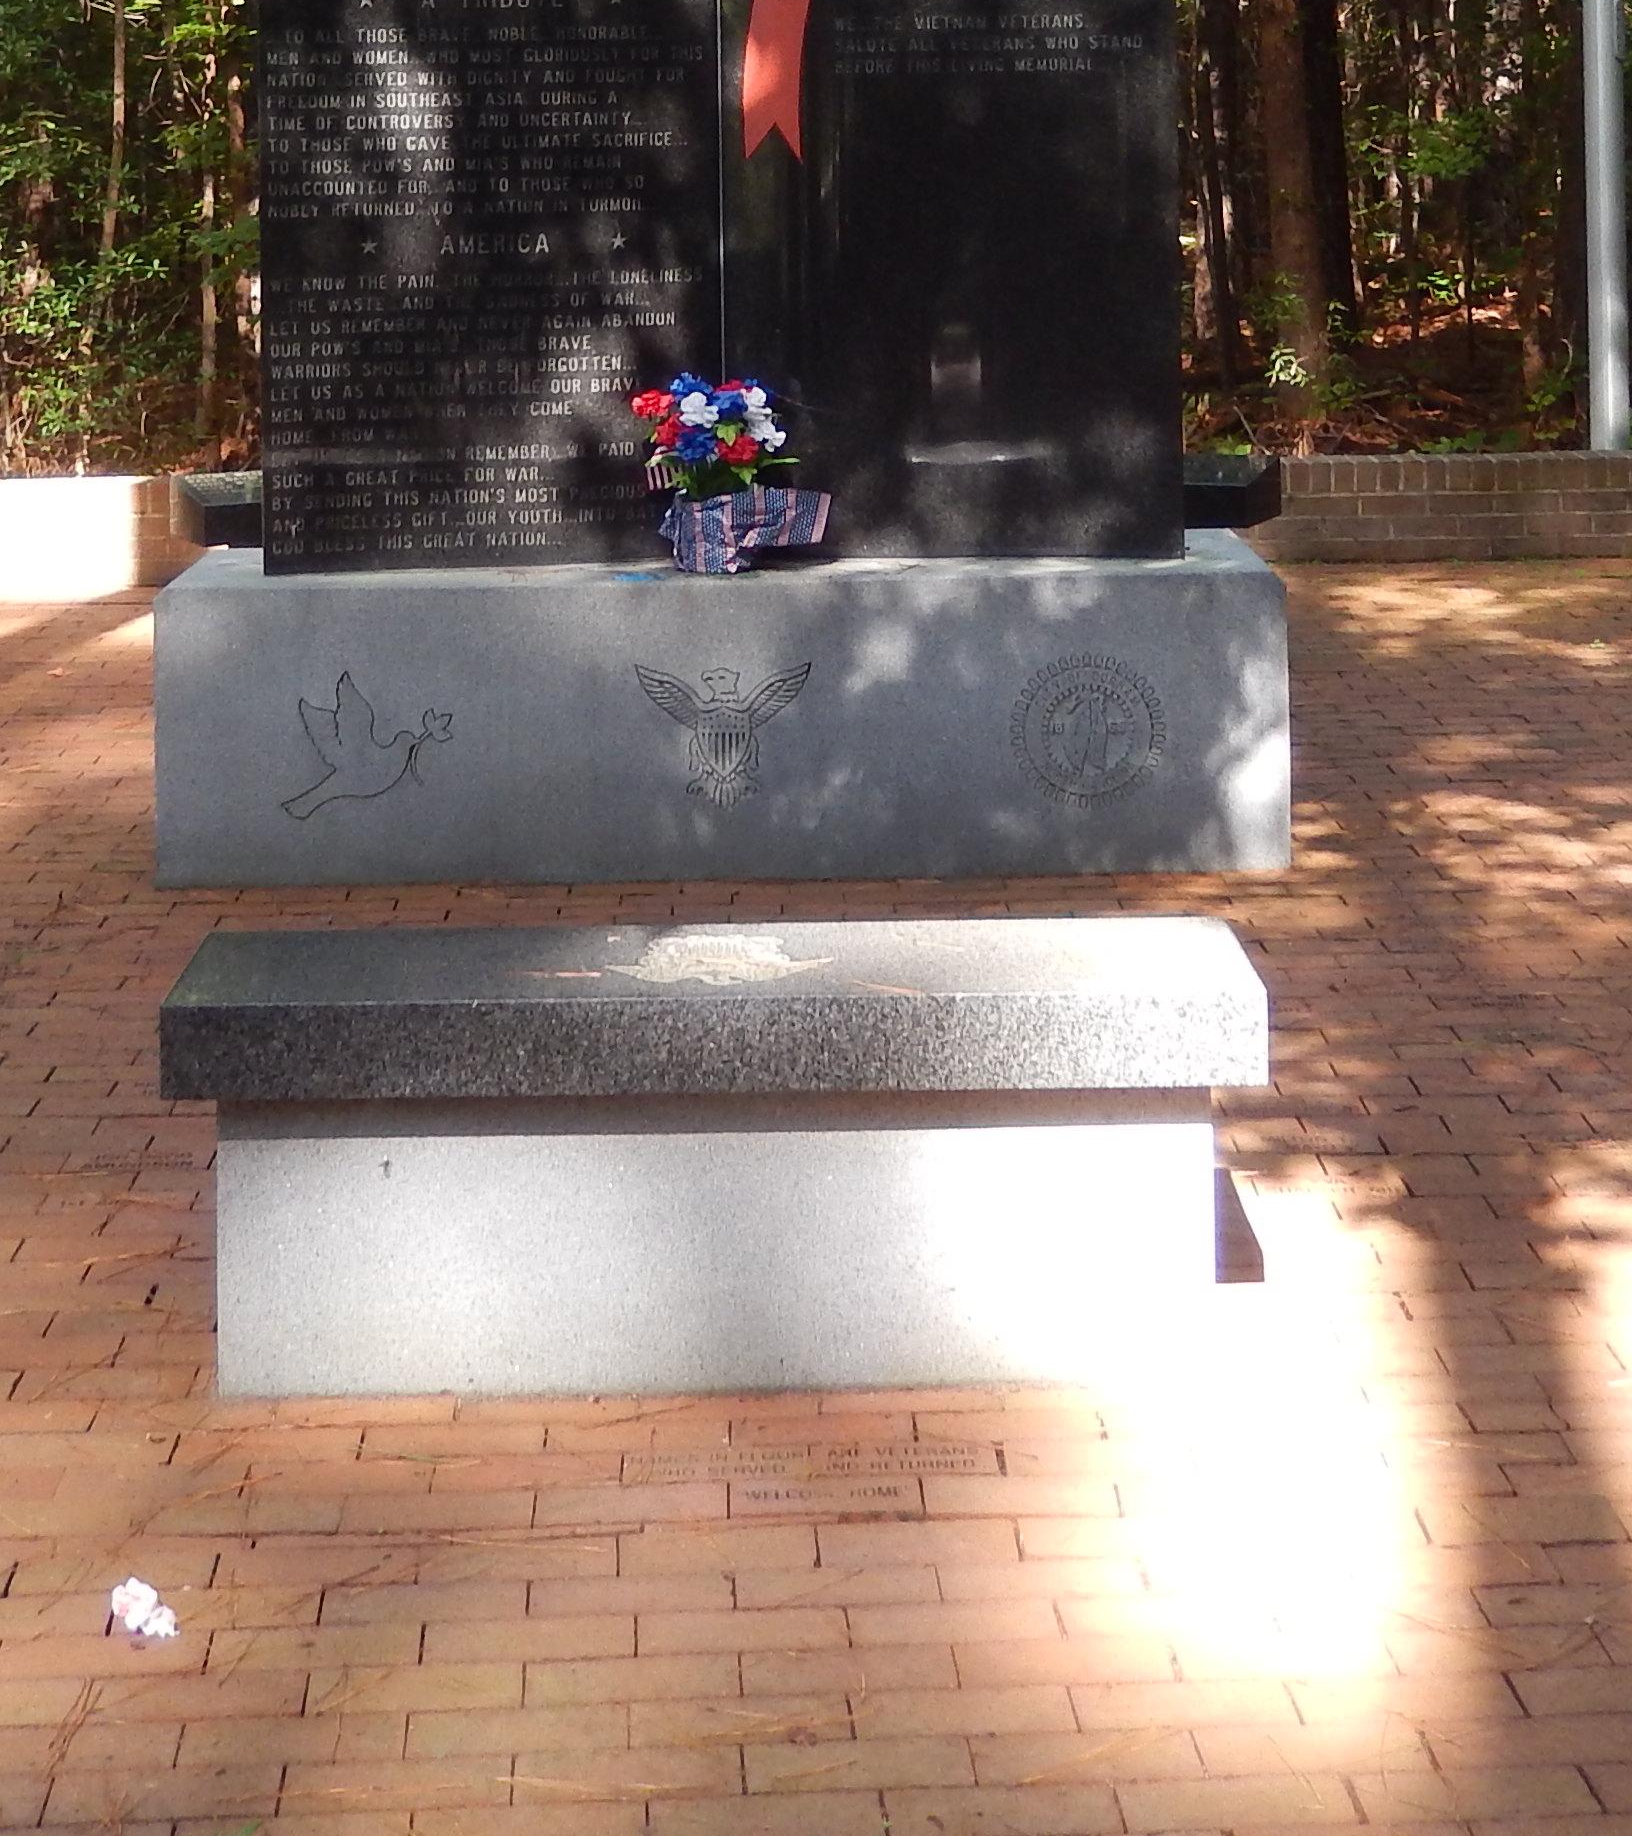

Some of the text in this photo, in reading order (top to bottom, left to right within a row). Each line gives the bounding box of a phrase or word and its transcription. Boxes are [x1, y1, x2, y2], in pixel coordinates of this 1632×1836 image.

[357, 28, 407, 44] THOSE
[1045, 36, 1078, 50] WHO
[1089, 34, 1143, 49] STAND
[267, 52, 299, 65] MEN
[543, 70, 575, 84] AND
[350, 94, 366, 108] IN
[608, 90, 617, 104] A
[268, 116, 306, 131] TIME
[318, 116, 334, 131] OF
[477, 113, 509, 128] AND
[269, 138, 289, 153] TO
[300, 137, 352, 153] THOSE
[363, 137, 396, 152] WHO
[406, 136, 450, 151] GAVE
[269, 160, 289, 175] TO
[302, 160, 352, 175] THOSE
[423, 158, 455, 172] AND
[268, 180, 387, 196] UNACCOUNTED
[440, 233, 550, 255] AMERICA
[302, 277, 346, 291] KNOW
[358, 275, 387, 290] THE
[570, 292, 588, 307] OF
[270, 321, 300, 336] LET
[311, 320, 331, 334] US
[601, 312, 675, 327] ABANDON
[271, 343, 301, 358] OUR
[271, 363, 352, 380] WARRIORS
[270, 386, 300, 402] LET
[311, 385, 331, 400] US
[343, 385, 364, 399] AS
[375, 384, 385, 396] A
[551, 379, 581, 394] OUR
[271, 400, 573, 423] MEN AND COME
[271, 430, 312, 445] HOME
[599, 441, 635, 457] PAID
[272, 473, 314, 489] SUCH
[345, 470, 399, 486] GREAT
[464, 467, 494, 483] FOR
[272, 496, 294, 511] BY
[384, 491, 419, 506] THIS
[429, 488, 505, 504] NATION'S
[516, 488, 559, 503] MOST
[378, 534, 412, 549] THIS
[423, 531, 476, 549] GREAT
